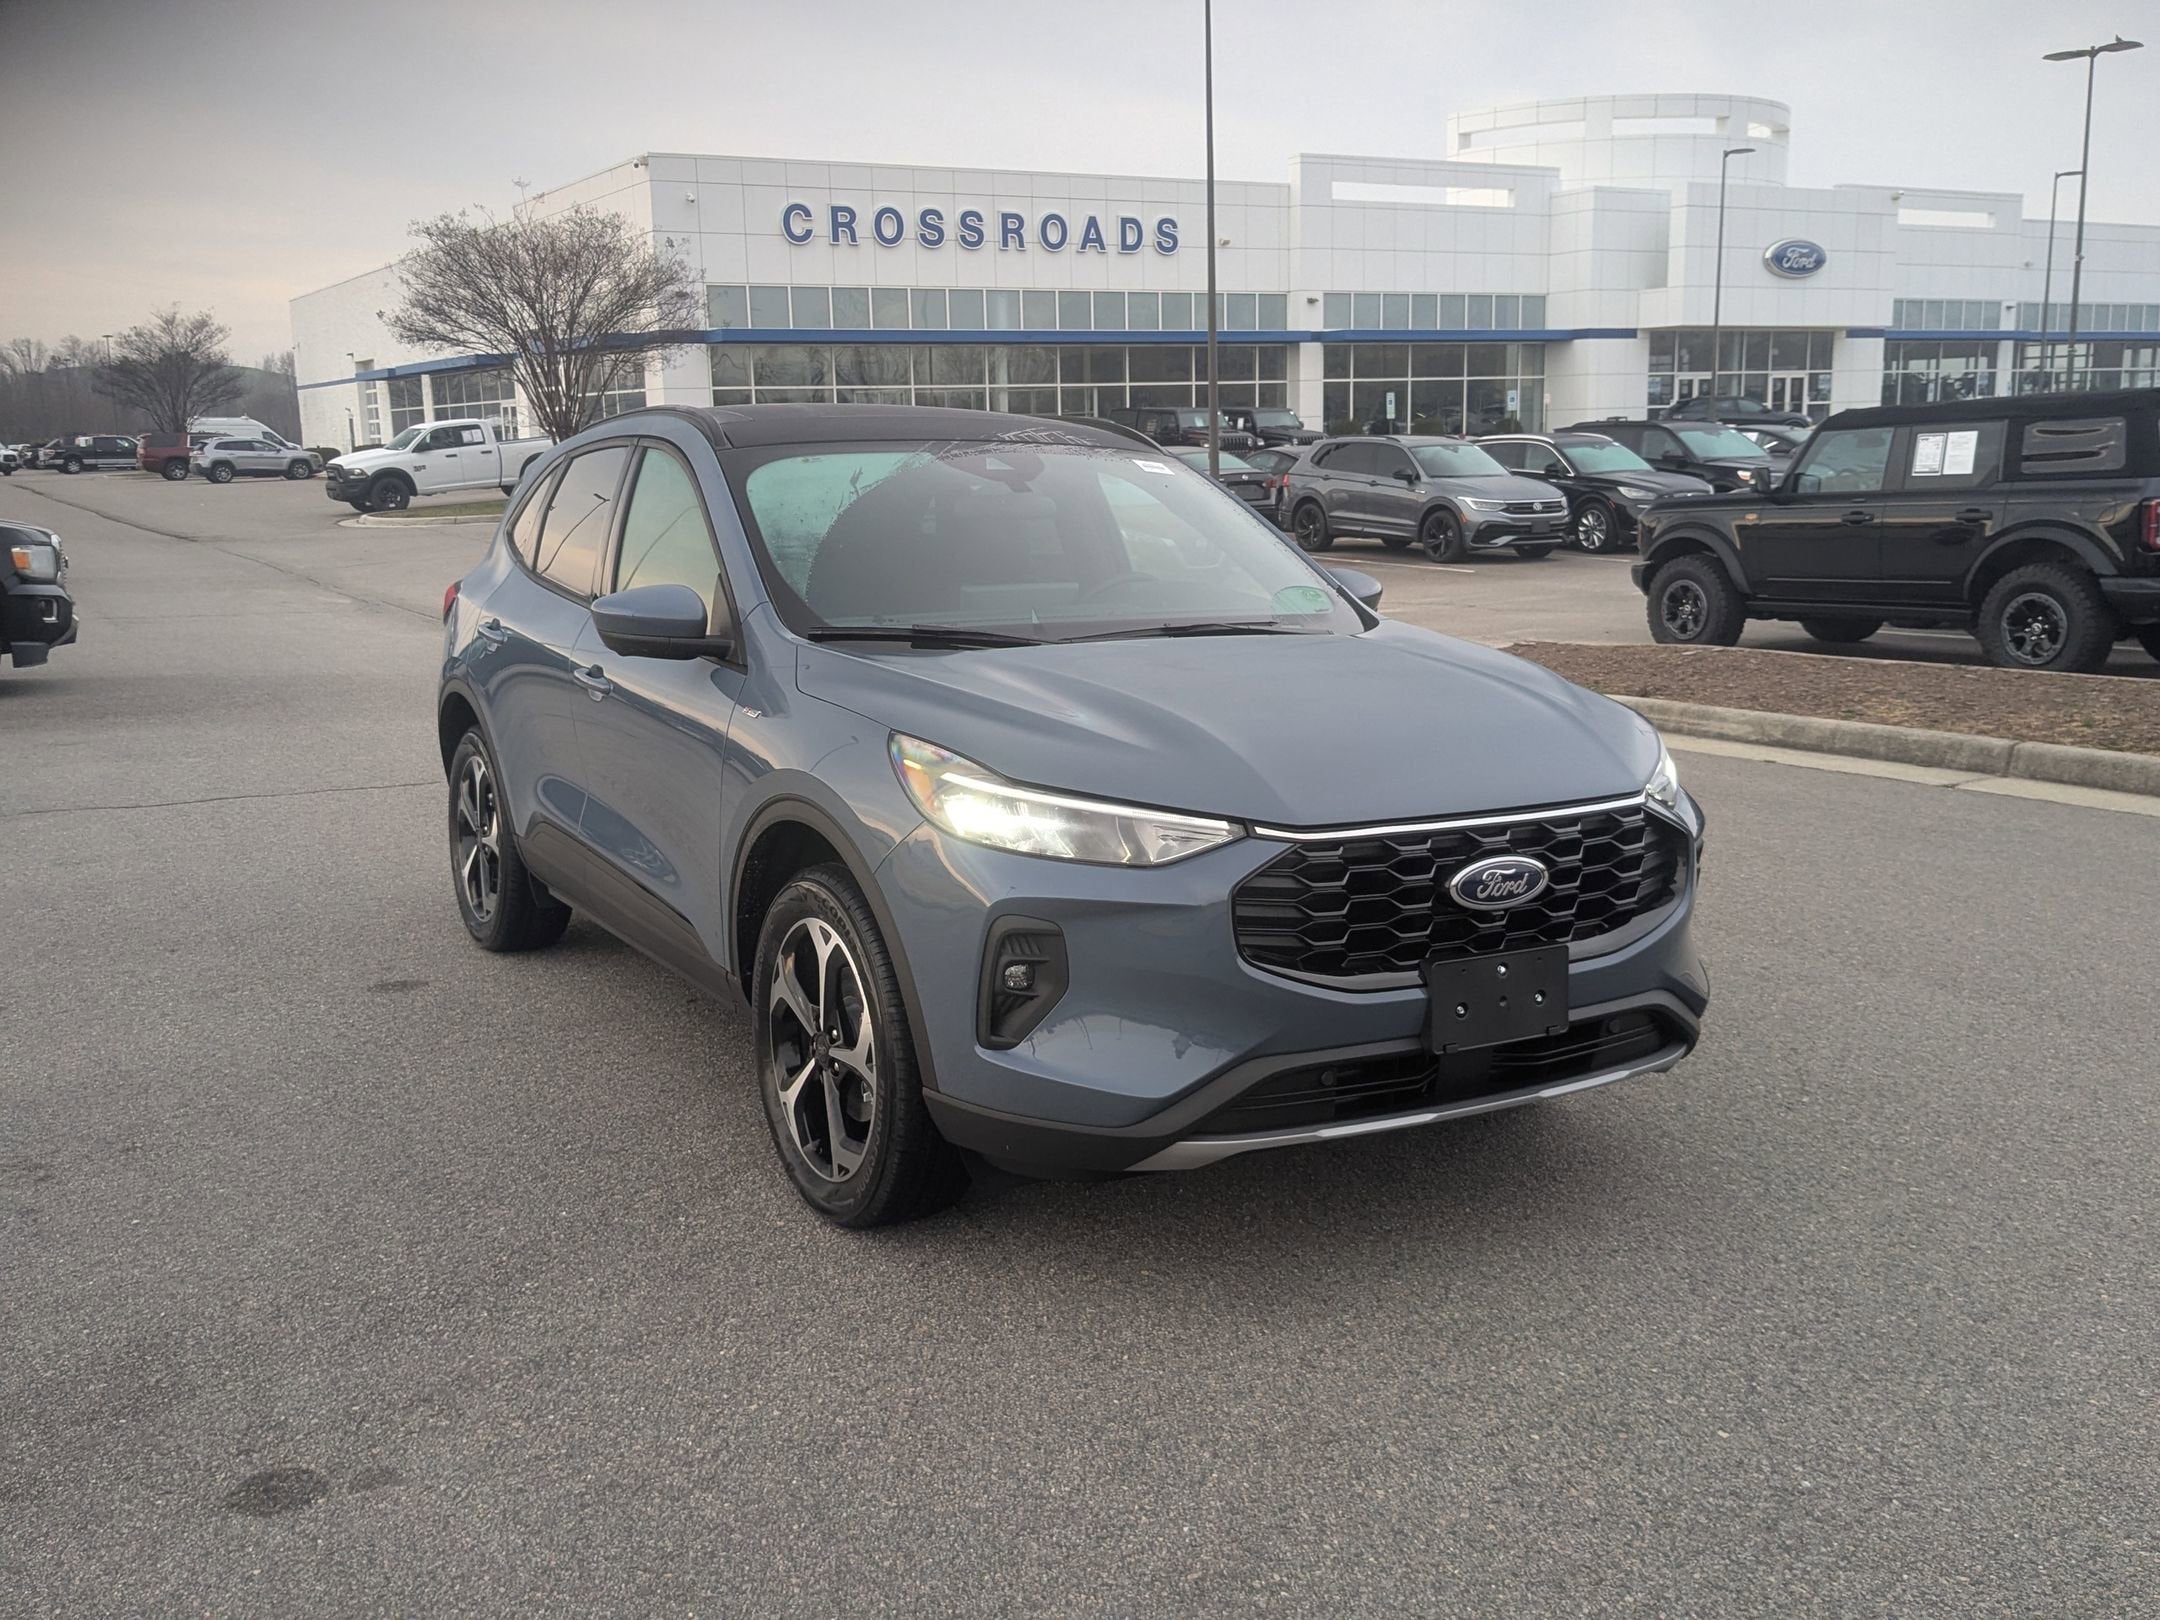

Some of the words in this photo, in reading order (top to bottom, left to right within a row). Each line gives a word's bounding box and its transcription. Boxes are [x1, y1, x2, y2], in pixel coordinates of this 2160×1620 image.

[781, 202, 1180, 256] CROSSROADS
[1782, 247, 1818, 268] Ford
[1476, 868, 1529, 899] Ford
